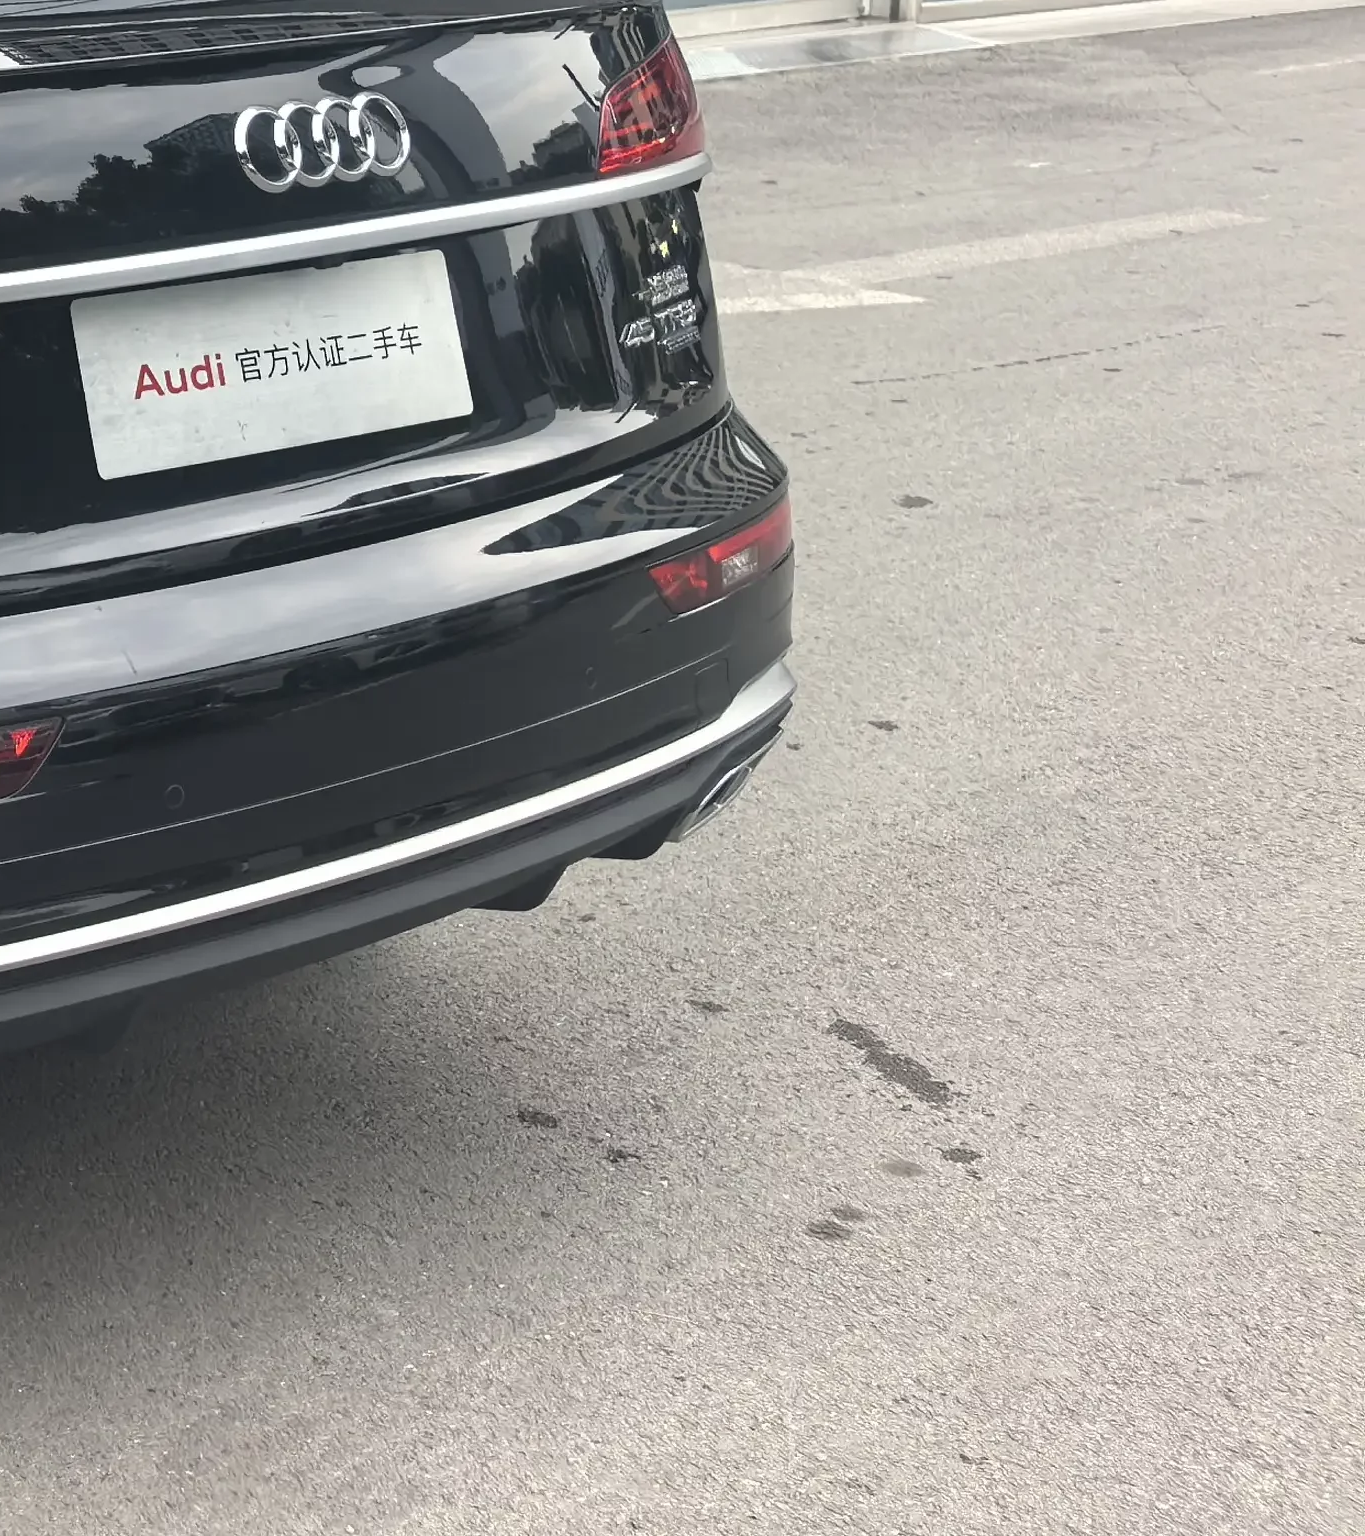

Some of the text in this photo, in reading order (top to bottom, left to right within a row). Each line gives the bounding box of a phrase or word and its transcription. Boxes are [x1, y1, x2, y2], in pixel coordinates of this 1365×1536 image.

[134, 323, 422, 400] Audi 官方认证二手车
